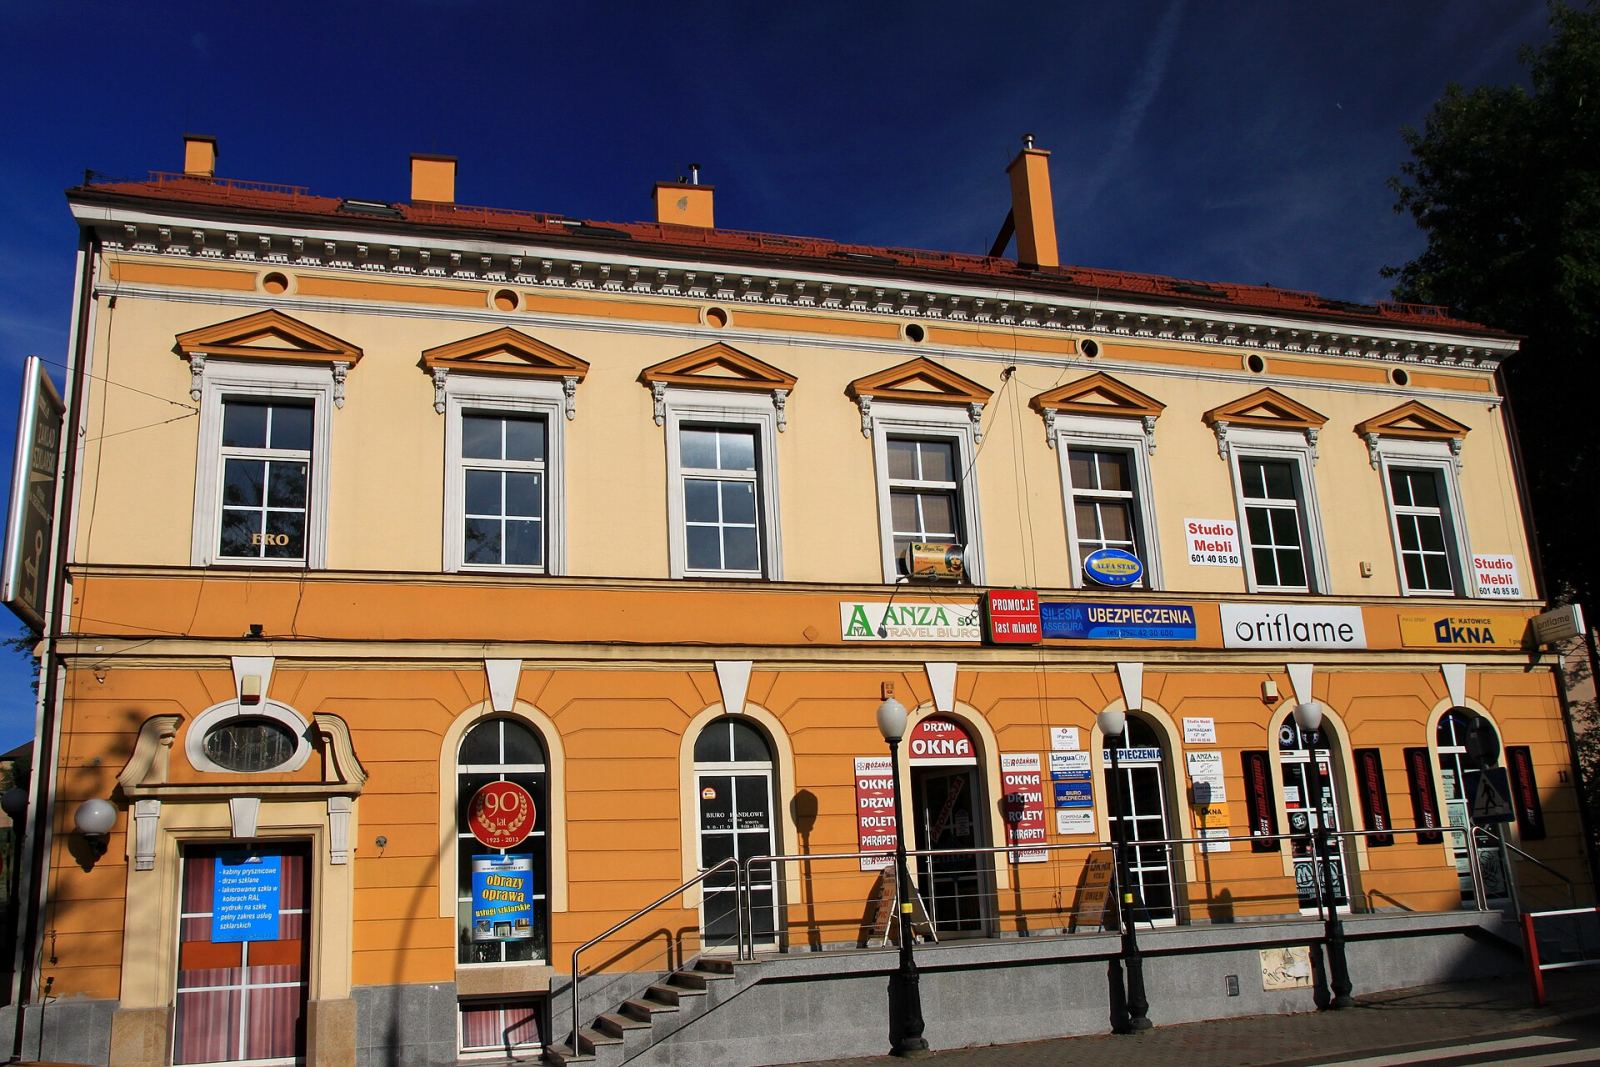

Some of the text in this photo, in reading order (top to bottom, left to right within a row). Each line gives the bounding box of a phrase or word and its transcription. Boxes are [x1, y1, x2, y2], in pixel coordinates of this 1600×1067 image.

[1188, 522, 1234, 536] Studio
[1194, 540, 1233, 552] Mebli
[1191, 554, 1239, 564] 601 40 85 80
[1474, 557, 1513, 569] Studio
[1480, 574, 1513, 585] Mebli
[1479, 587, 1519, 595] 601 40 85 80
[992, 598, 1035, 611] PROMOCJE
[882, 606, 950, 626] ANZA
[1041, 607, 1083, 620] SILESIA
[1088, 607, 1192, 624] UBEZPIECZENIA
[1043, 622, 1084, 632] ASSECURA
[1536, 614, 1571, 630] oriflame
[886, 628, 981, 638] TRAVEL BIURO
[994, 622, 1038, 634] last minute
[1235, 613, 1354, 643] oriflame
[923, 722, 956, 732] DRZWI
[911, 739, 969, 755] OKNA
[1051, 754, 1087, 763] LinguaCity
[1103, 749, 1162, 760] BZPIECZENIA
[865, 761, 893, 771] RÓŻAŃSK
[1010, 758, 1038, 766] RÓŻAŃSKI
[859, 779, 894, 790] OKNA
[1005, 775, 1040, 785] OKNA
[860, 798, 895, 808] DRZW
[1008, 792, 1042, 803] DRZWI
[484, 791, 520, 818] 90
[1008, 810, 1043, 821] ROLETY
[496, 817, 507, 826] lat
[1009, 828, 1045, 839] PARAPETY
[222, 868, 277, 876] kabiny prysznicowe
[486, 874, 525, 890] obrazy
[482, 889, 525, 903] oprawa
[498, 903, 531, 914] szklarskie
[219, 922, 252, 930] szklarskich
